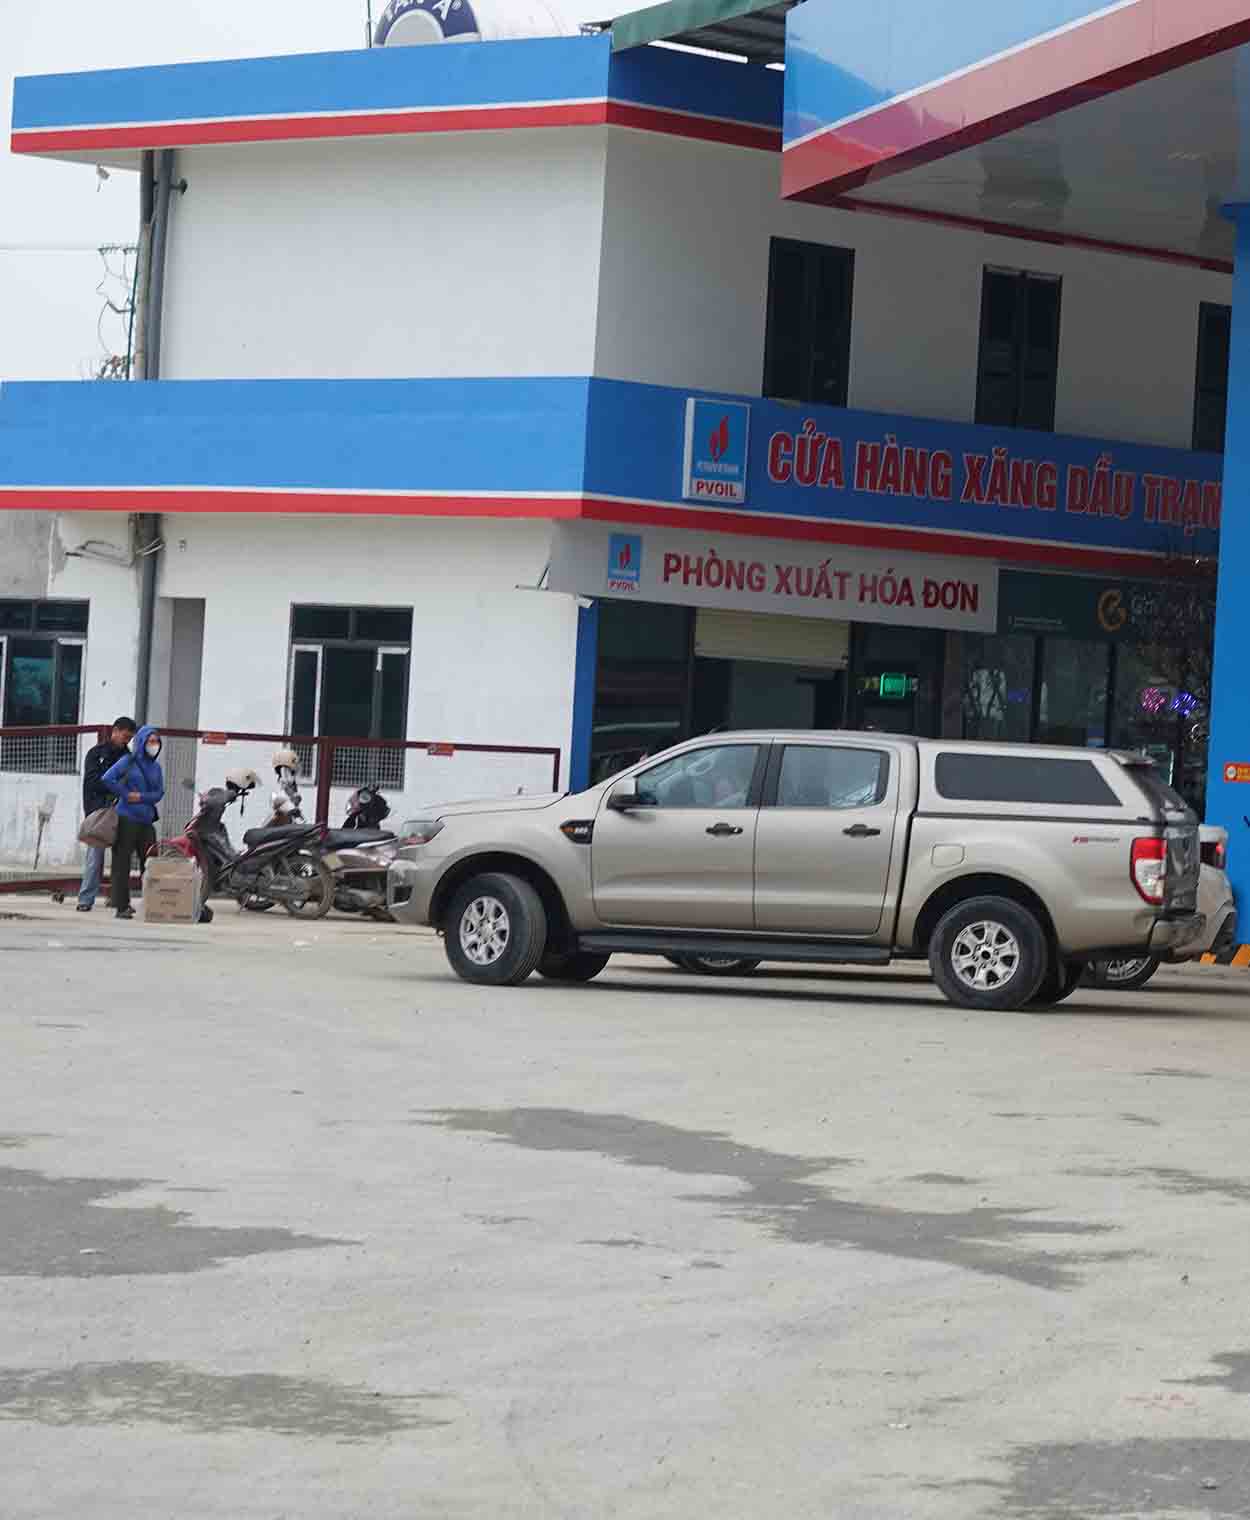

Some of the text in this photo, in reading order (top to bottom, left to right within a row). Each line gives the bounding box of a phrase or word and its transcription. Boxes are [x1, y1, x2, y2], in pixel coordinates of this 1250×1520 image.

[696, 480, 738, 497] PVOIL
[768, 417, 844, 488] CỬA
[854, 433, 953, 500] HÀNG
[960, 447, 1057, 511] XĂNG
[663, 548, 979, 613] PHÒNG XUẤT HÓA ĐƠN
